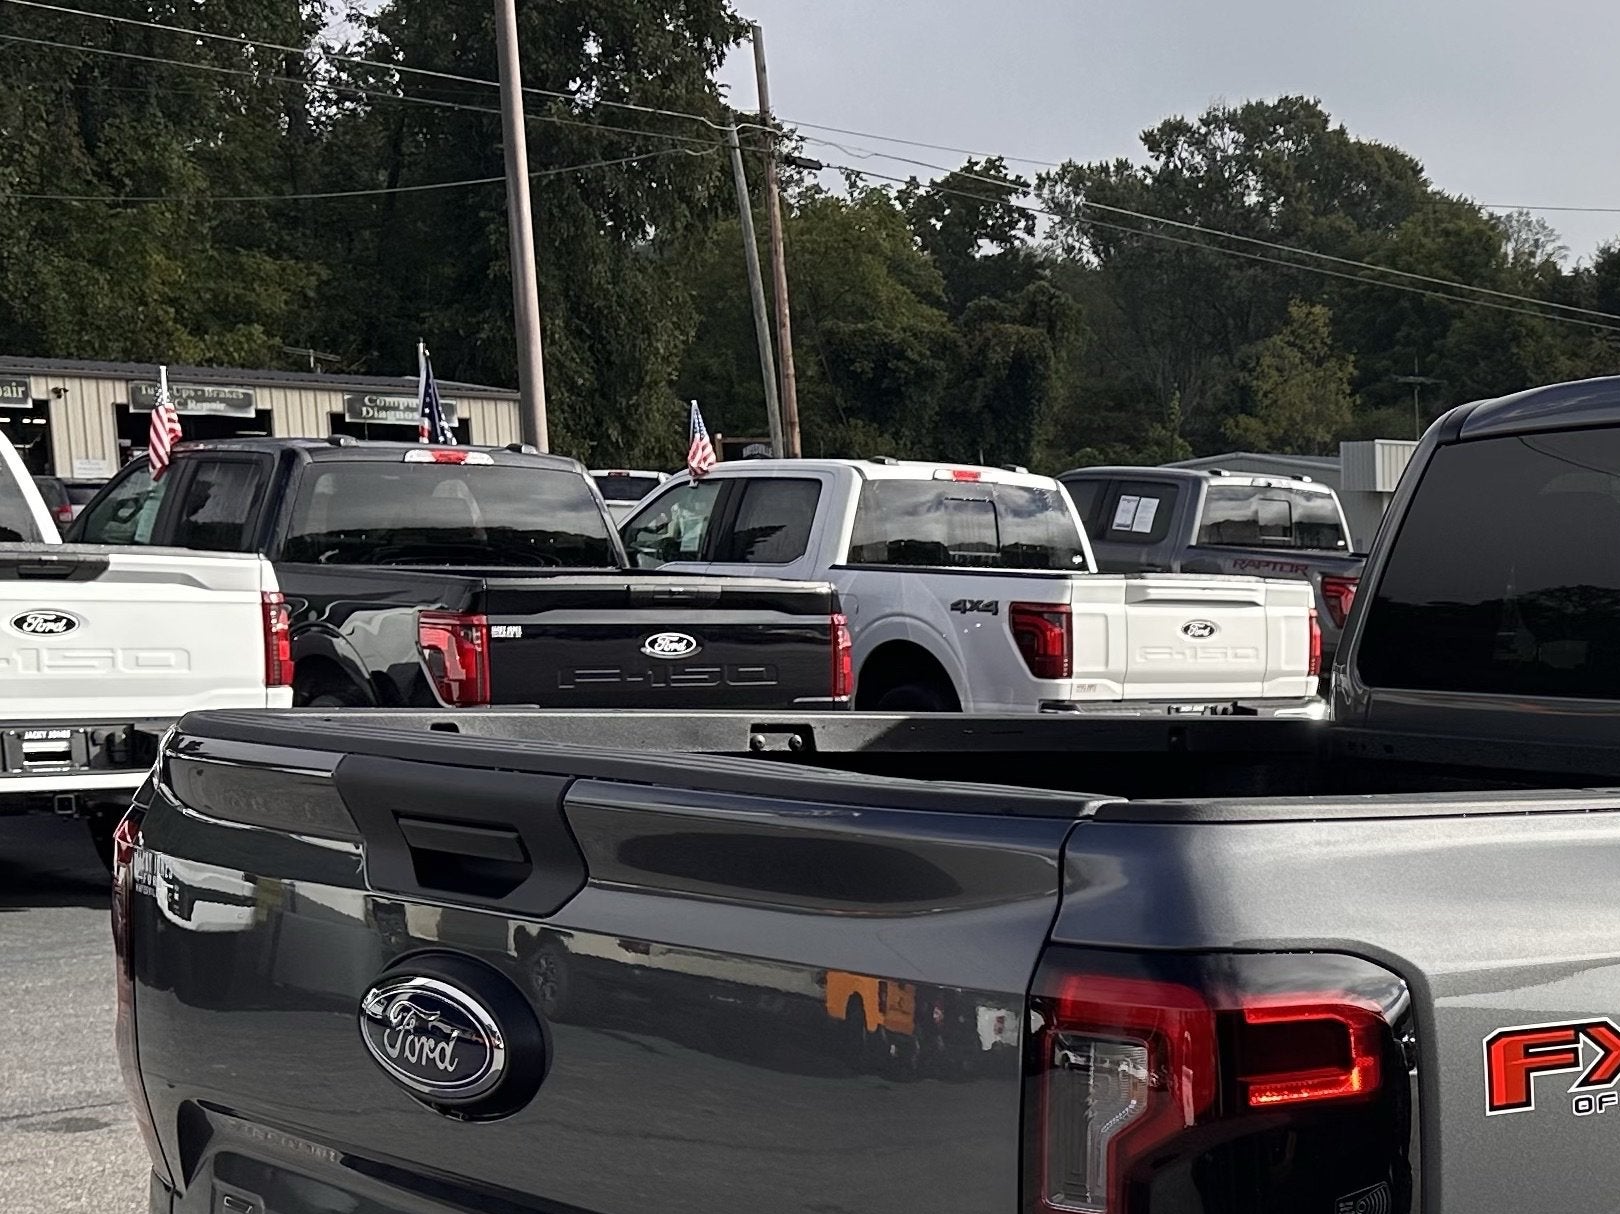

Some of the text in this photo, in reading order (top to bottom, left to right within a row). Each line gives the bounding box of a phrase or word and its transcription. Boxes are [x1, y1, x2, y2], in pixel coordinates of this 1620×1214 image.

[141, 384, 244, 399] Tu-Ups Brakes
[187, 400, 226, 411] Repair
[364, 395, 419, 411] Compu
[361, 406, 422, 421] Diagnos
[1232, 558, 1310, 576] RAPTOR
[23, 613, 68, 633] Ford
[653, 635, 689, 653] Ford
[1135, 645, 1261, 664] F-150
[557, 663, 779, 689] F-150
[384, 999, 460, 1073] Ford
